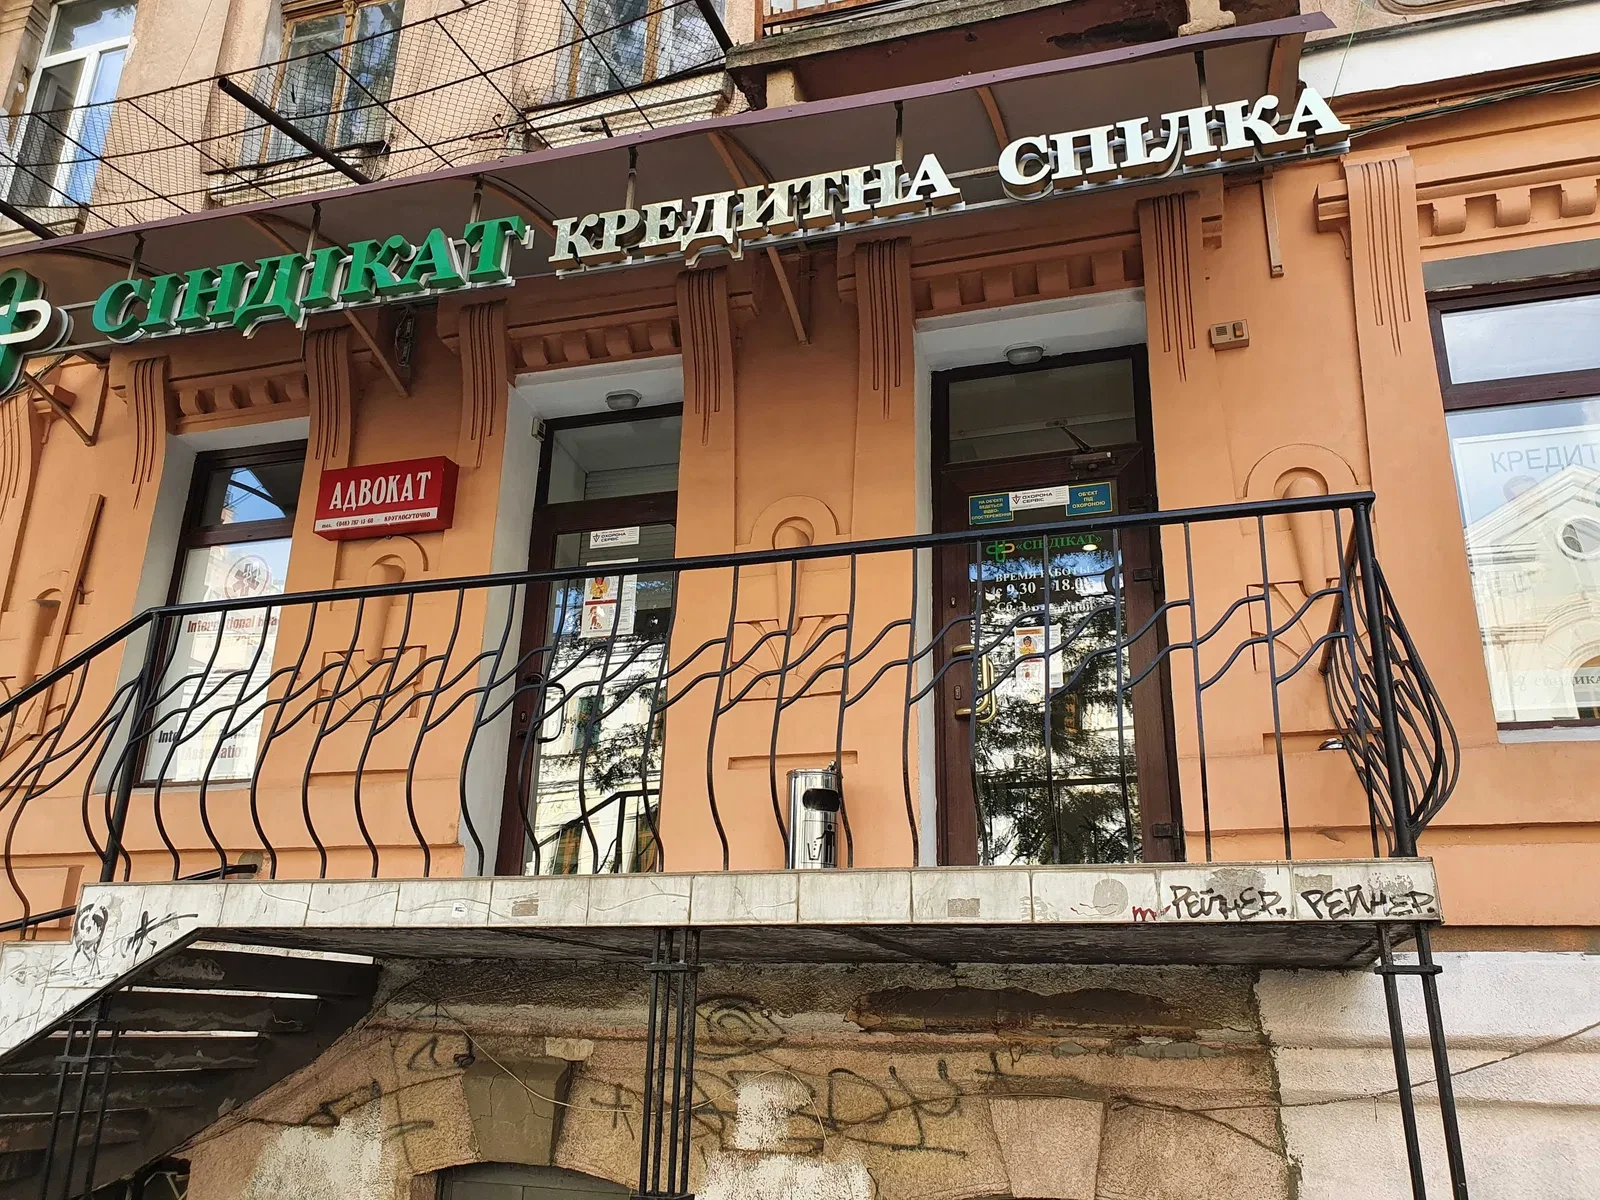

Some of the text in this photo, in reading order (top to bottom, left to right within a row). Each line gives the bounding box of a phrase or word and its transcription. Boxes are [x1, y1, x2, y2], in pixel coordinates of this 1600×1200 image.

[92, 88, 1351, 341] СІНДІКАТ КРЕДИТНА СПІЛКА
[1490, 443, 1598, 473] КРЕДИТ
[329, 471, 432, 512] АДВОКАТ
[1022, 492, 1053, 500] ОХОРОНА
[1071, 500, 1106, 510] ОХОРОНОЮ
[384, 511, 431, 522] КРУГЛОСУТОЧНО
[995, 570, 1038, 583] ВРЕМЯ
